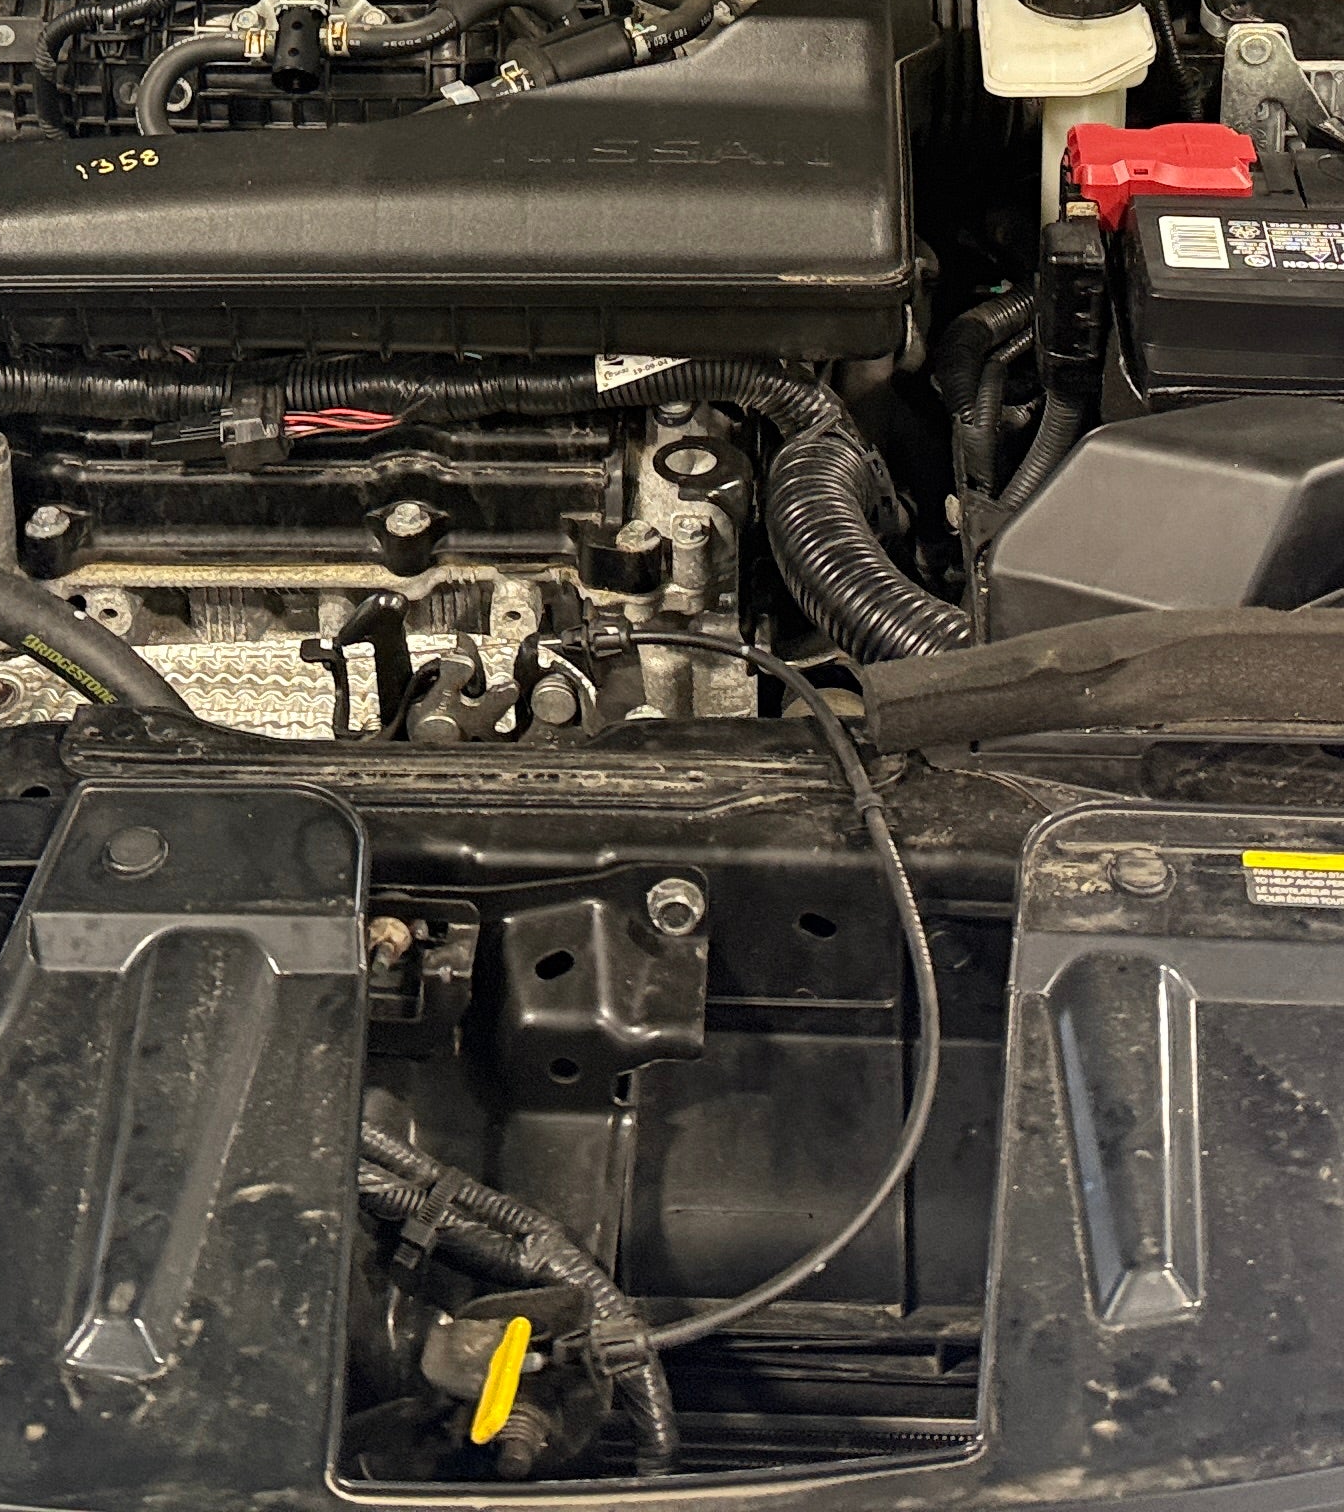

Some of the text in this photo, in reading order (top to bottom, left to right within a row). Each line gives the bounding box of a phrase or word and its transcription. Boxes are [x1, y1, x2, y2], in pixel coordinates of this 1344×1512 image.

[74, 148, 160, 180] 1358
[492, 139, 833, 167] NISSAN
[21, 633, 119, 706] BRIDGESTONE
[1255, 876, 1269, 885] TO
[1256, 885, 1268, 894] LE
